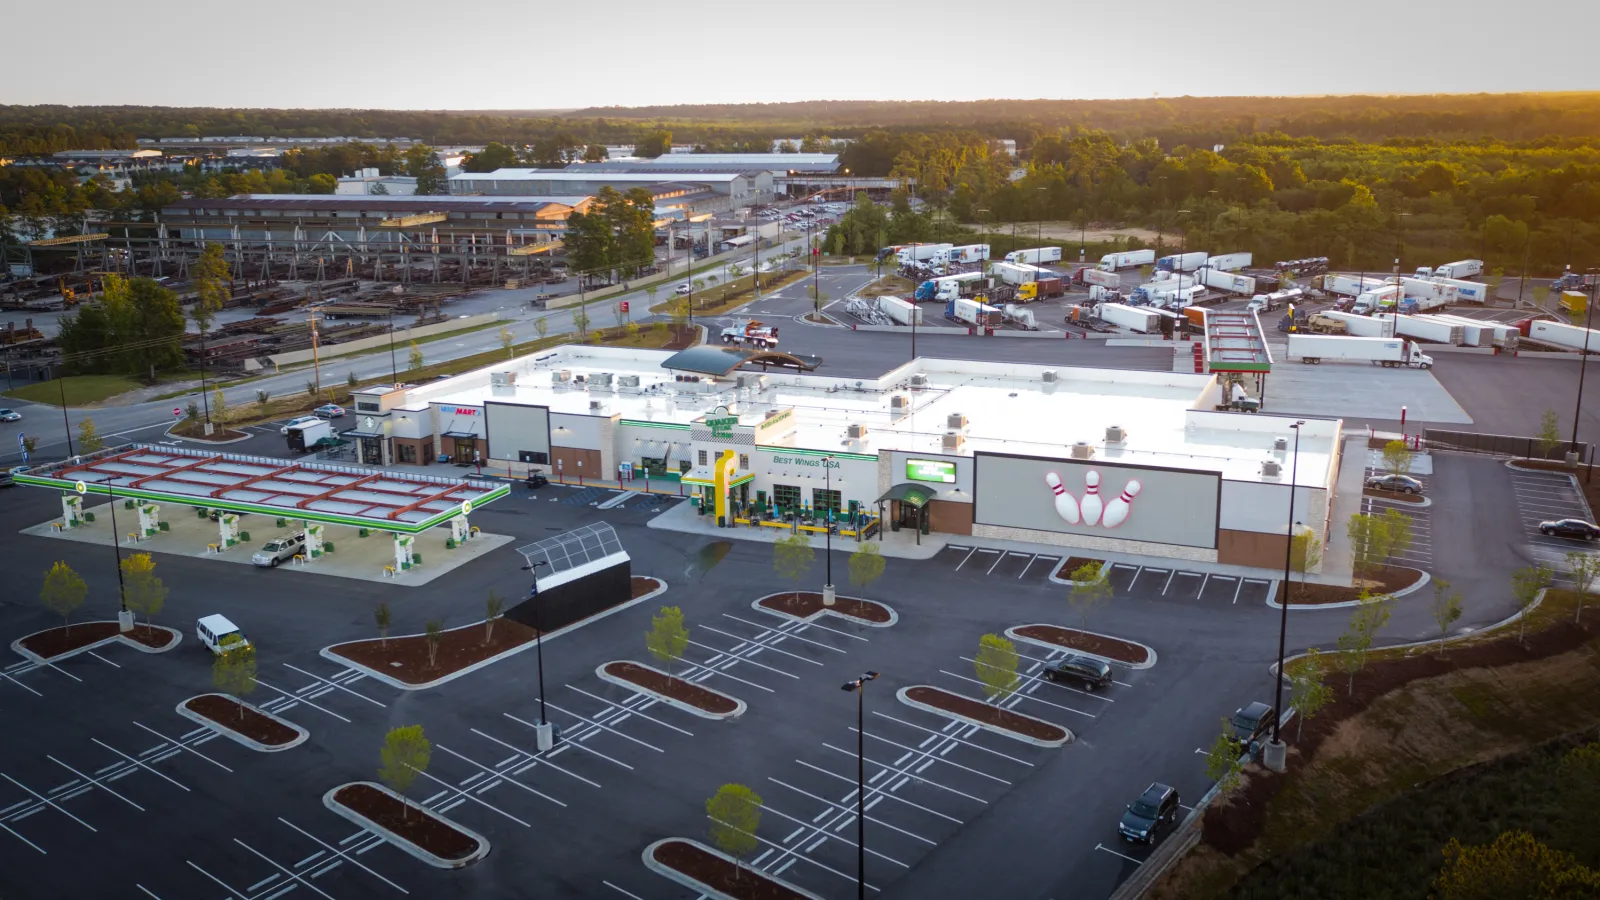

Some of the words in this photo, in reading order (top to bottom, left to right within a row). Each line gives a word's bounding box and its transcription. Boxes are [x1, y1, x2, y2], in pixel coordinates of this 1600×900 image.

[773, 455, 793, 464] BEST
[795, 458, 820, 467] WINGS
[822, 460, 840, 469] USA
